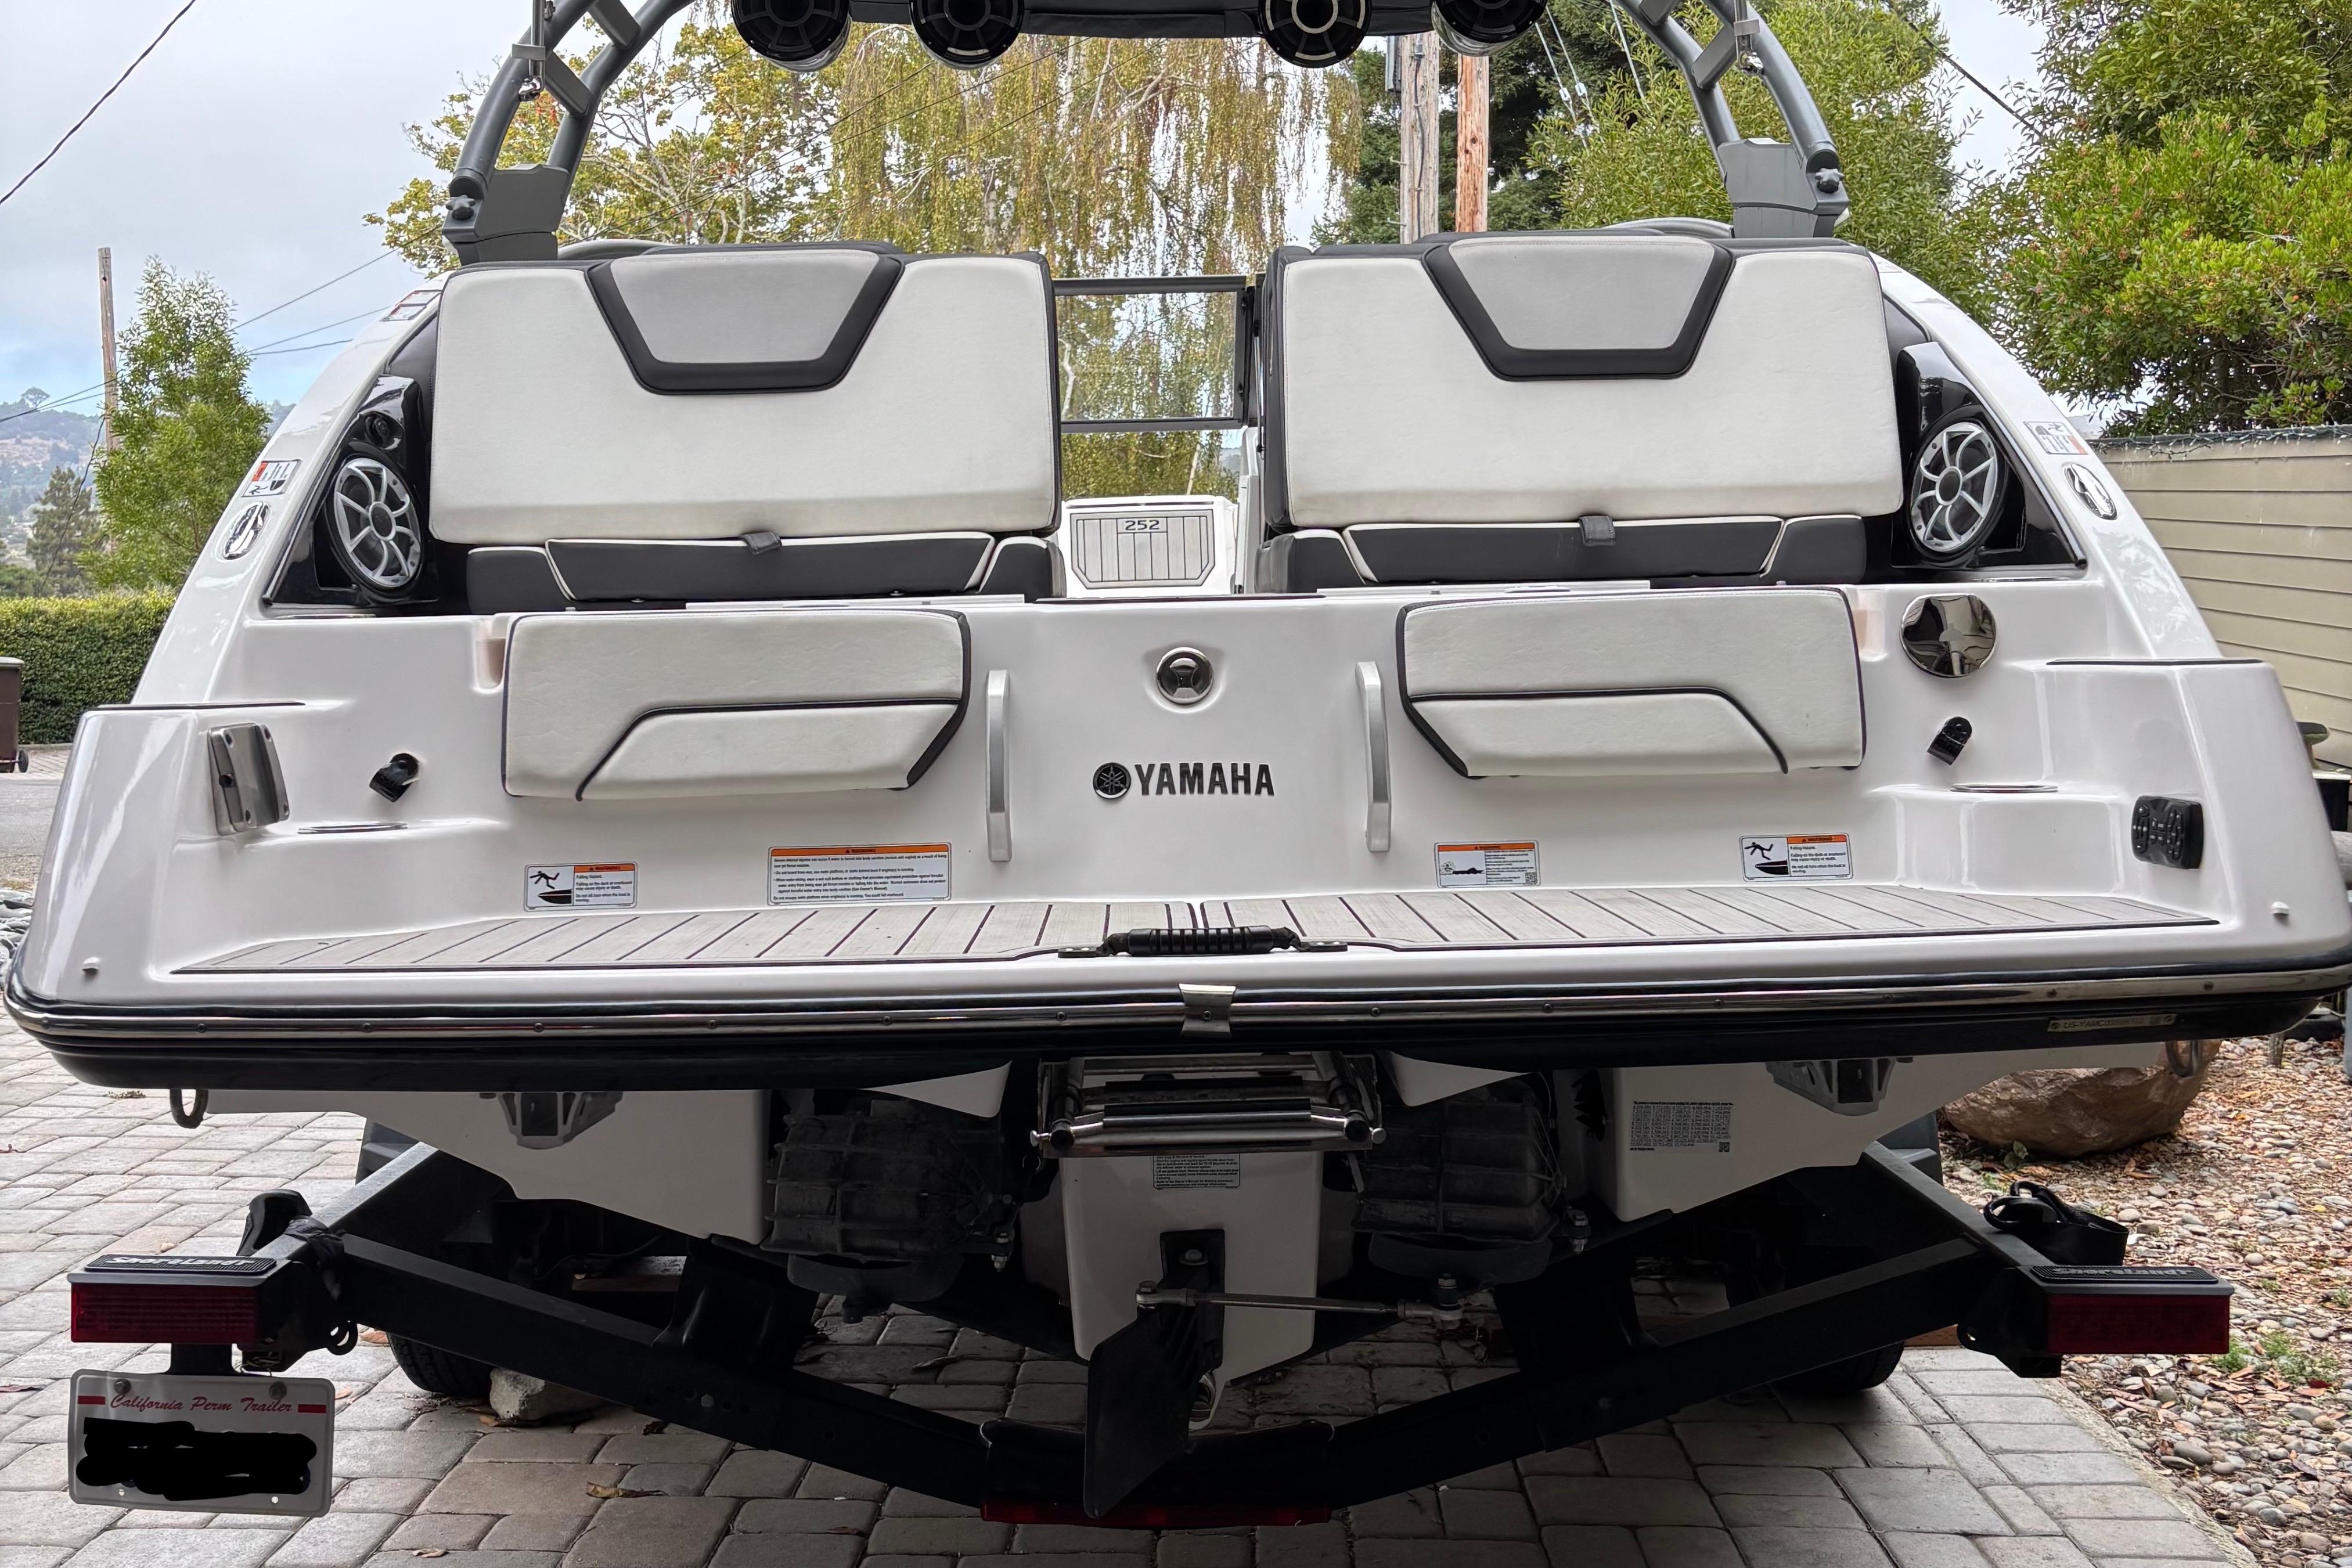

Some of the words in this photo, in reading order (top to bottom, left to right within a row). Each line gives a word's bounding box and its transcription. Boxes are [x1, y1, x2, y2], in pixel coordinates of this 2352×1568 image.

[1125, 520, 1160, 531] 252
[1134, 762, 1275, 796] YAMAHA
[110, 1393, 184, 1412] California
[190, 1396, 233, 1411] Perm
[240, 1396, 293, 1412] Trailer
